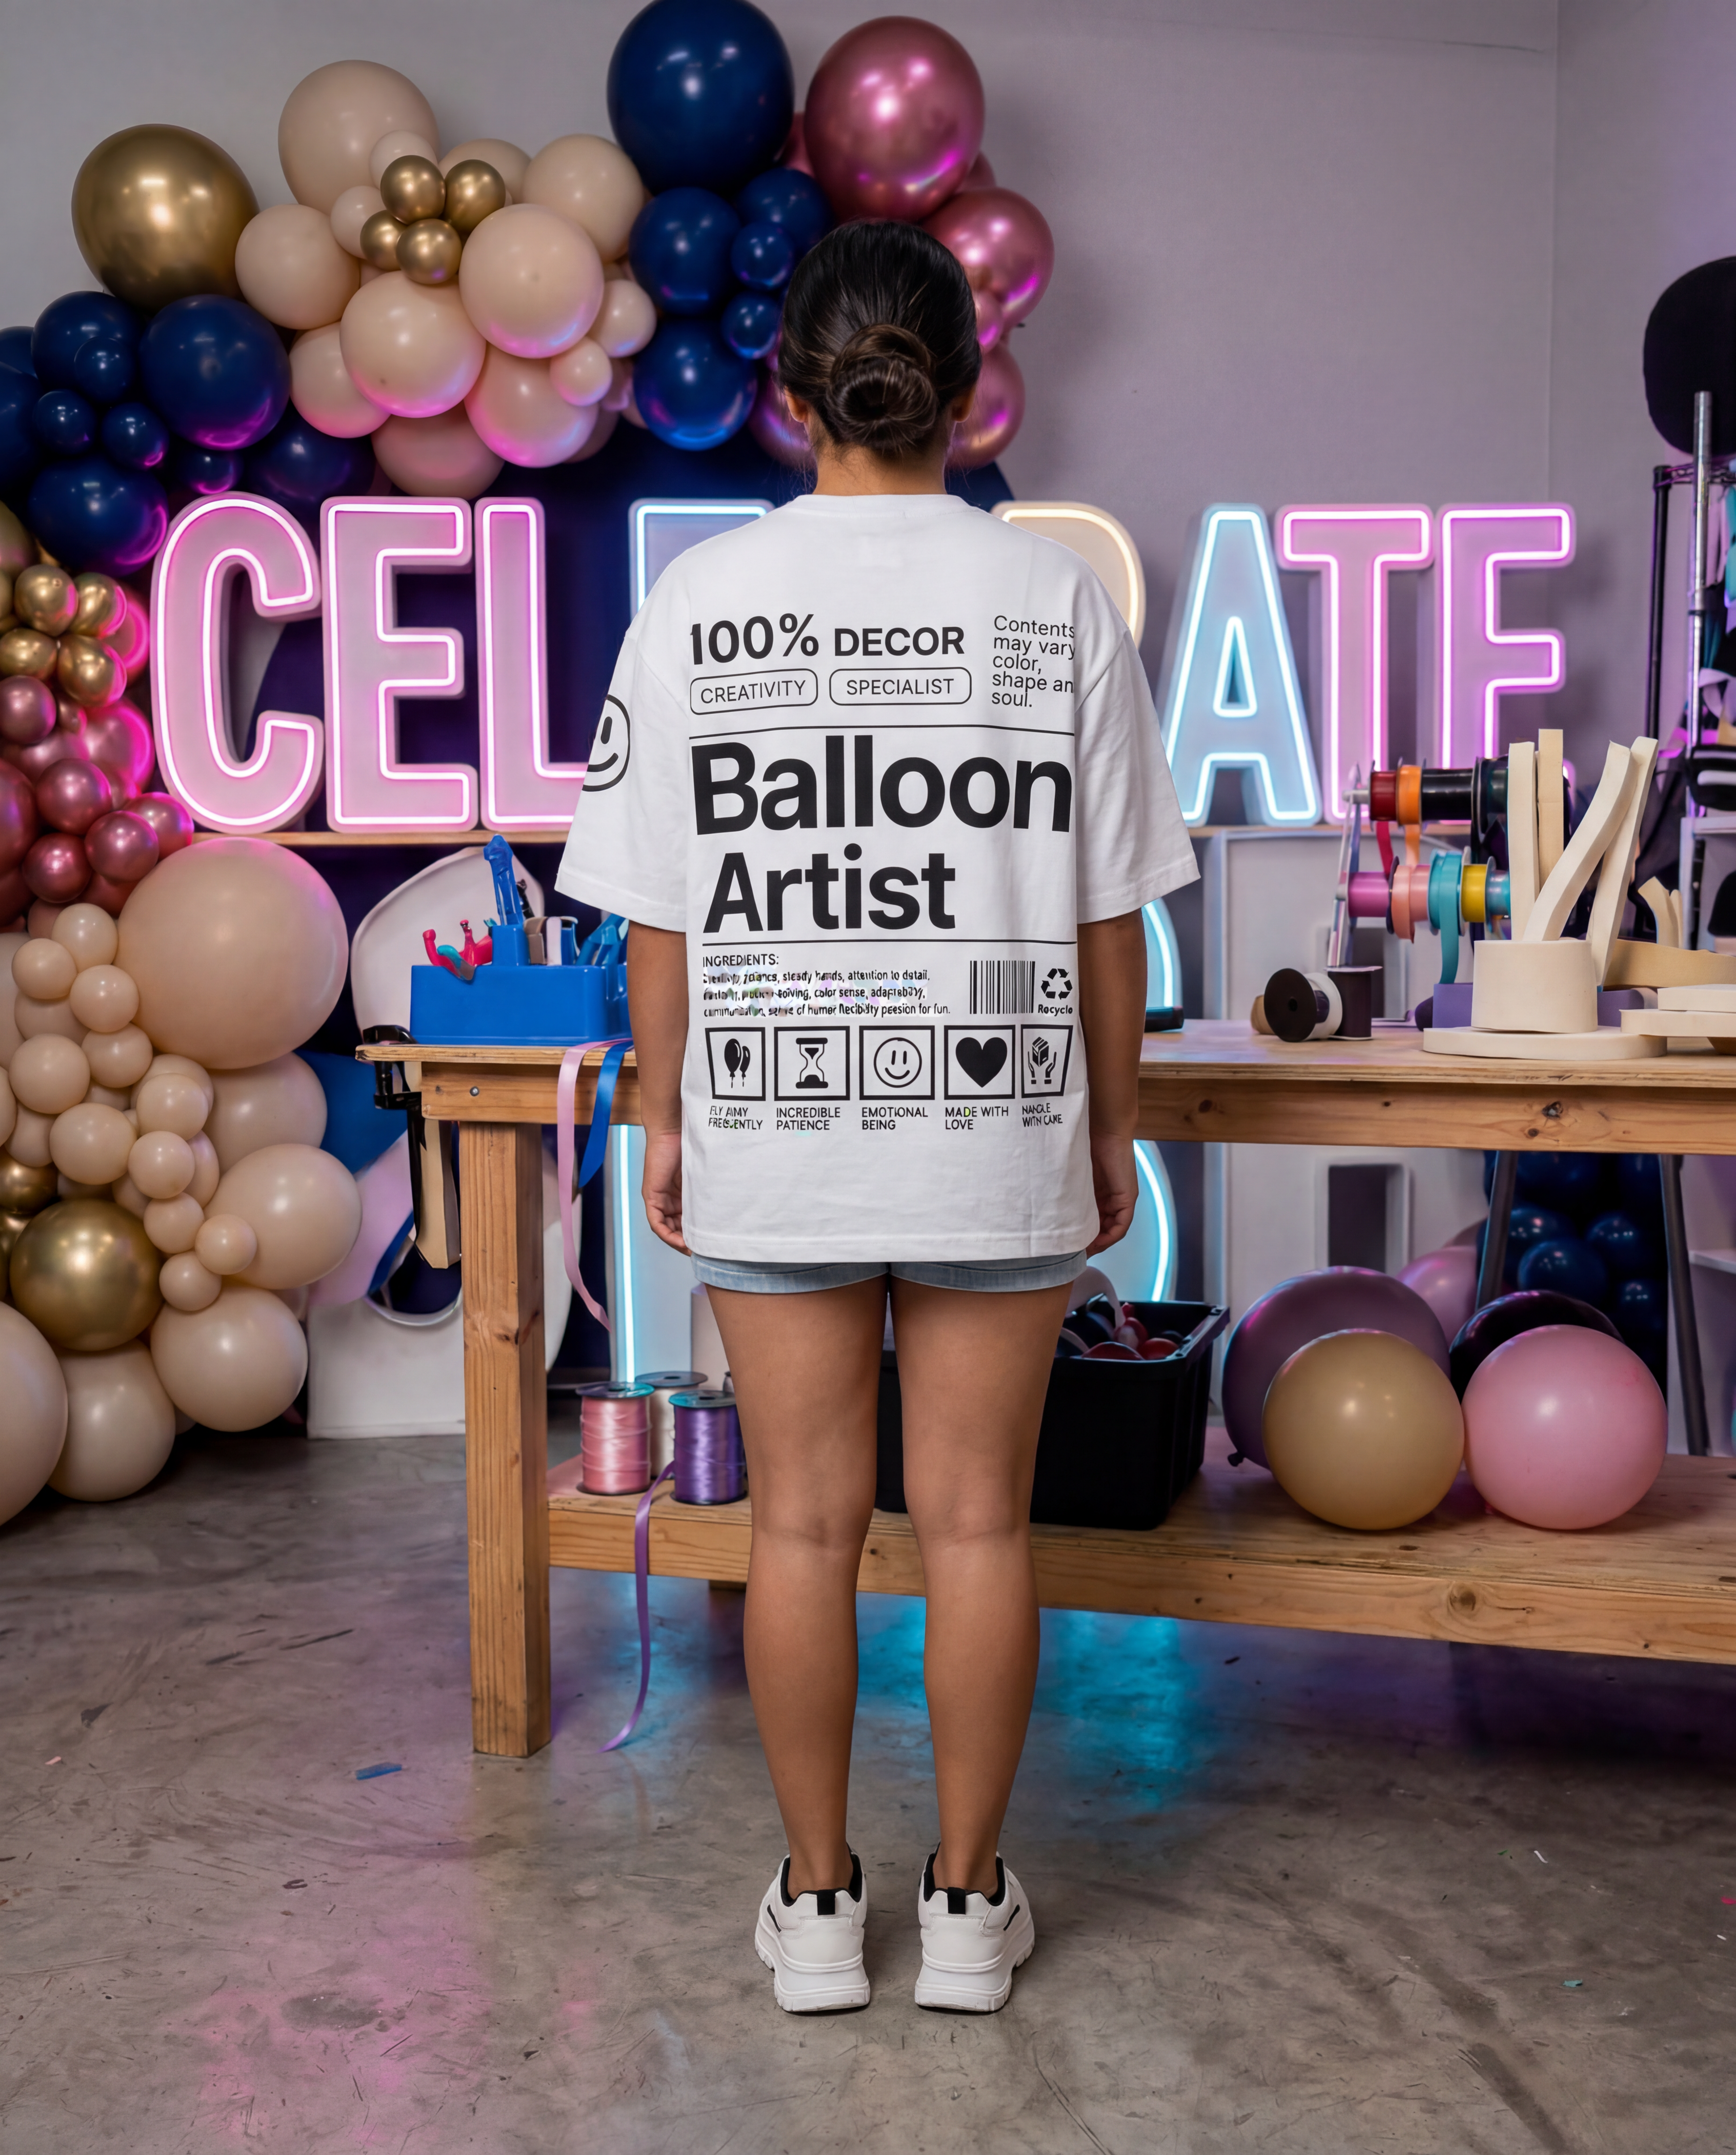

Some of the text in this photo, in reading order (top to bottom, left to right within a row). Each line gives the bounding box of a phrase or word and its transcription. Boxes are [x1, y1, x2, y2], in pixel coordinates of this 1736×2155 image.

[994, 615, 1075, 640] Contents
[690, 613, 819, 665] 100%
[834, 627, 965, 656] DECOR
[994, 637, 1076, 662] may vary
[993, 652, 1041, 675] color,
[847, 679, 954, 695] SPECIALIST
[992, 670, 1047, 693] shape
[700, 680, 806, 704] CREATIVITY
[991, 690, 1032, 708] soul.
[690, 735, 1072, 836] Balloon
[703, 843, 955, 933] Artist
[703, 954, 779, 967] INGREDIENTS:
[919, 1003, 931, 1014] for
[776, 1107, 840, 1118] INCREDIBLE
[862, 1106, 928, 1118] EMOTIONAL
[945, 1106, 1009, 1117] MADE WITH
[777, 1120, 830, 1130] PATIENCE
[862, 1119, 896, 1130] BEING
[945, 1119, 974, 1130] LOVE
